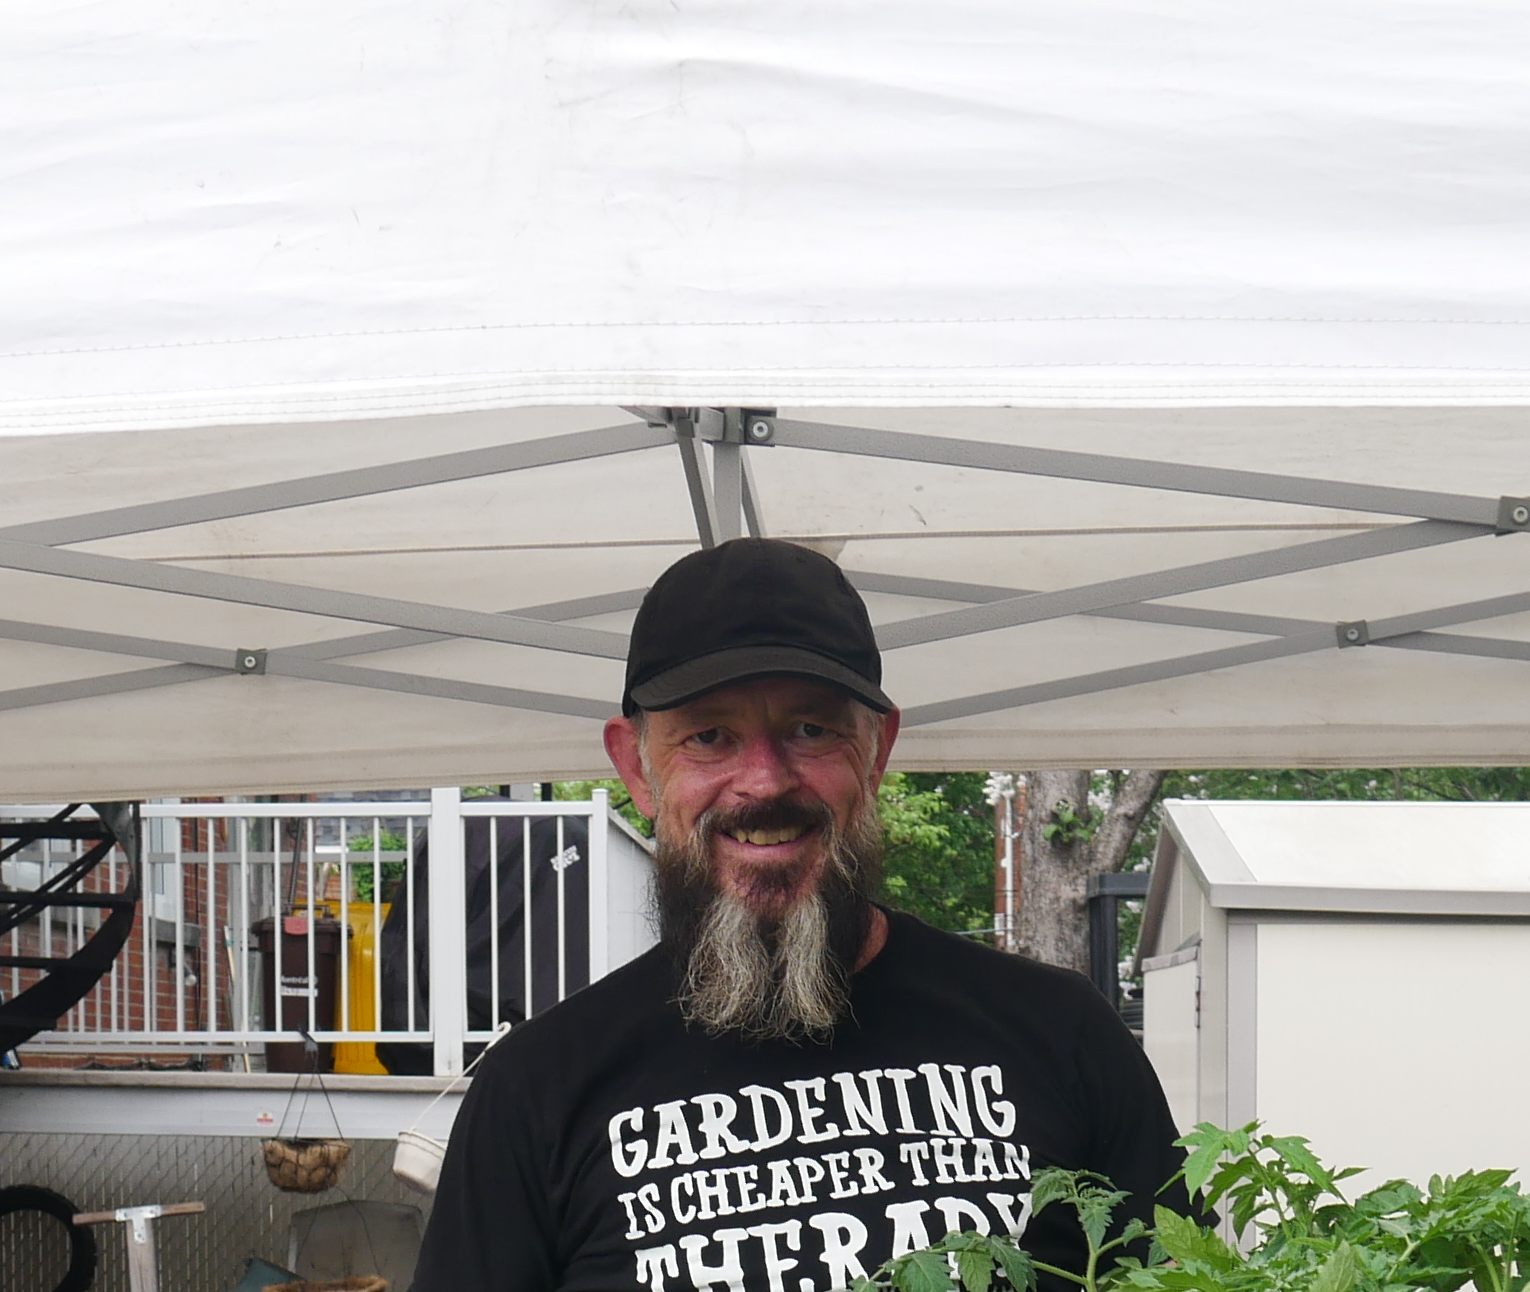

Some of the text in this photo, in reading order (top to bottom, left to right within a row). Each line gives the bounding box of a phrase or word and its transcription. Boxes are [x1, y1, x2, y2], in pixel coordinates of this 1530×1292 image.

[609, 1063, 1016, 1178] GARDENING
[617, 1138, 1031, 1240] IS CHEAPER THAN
